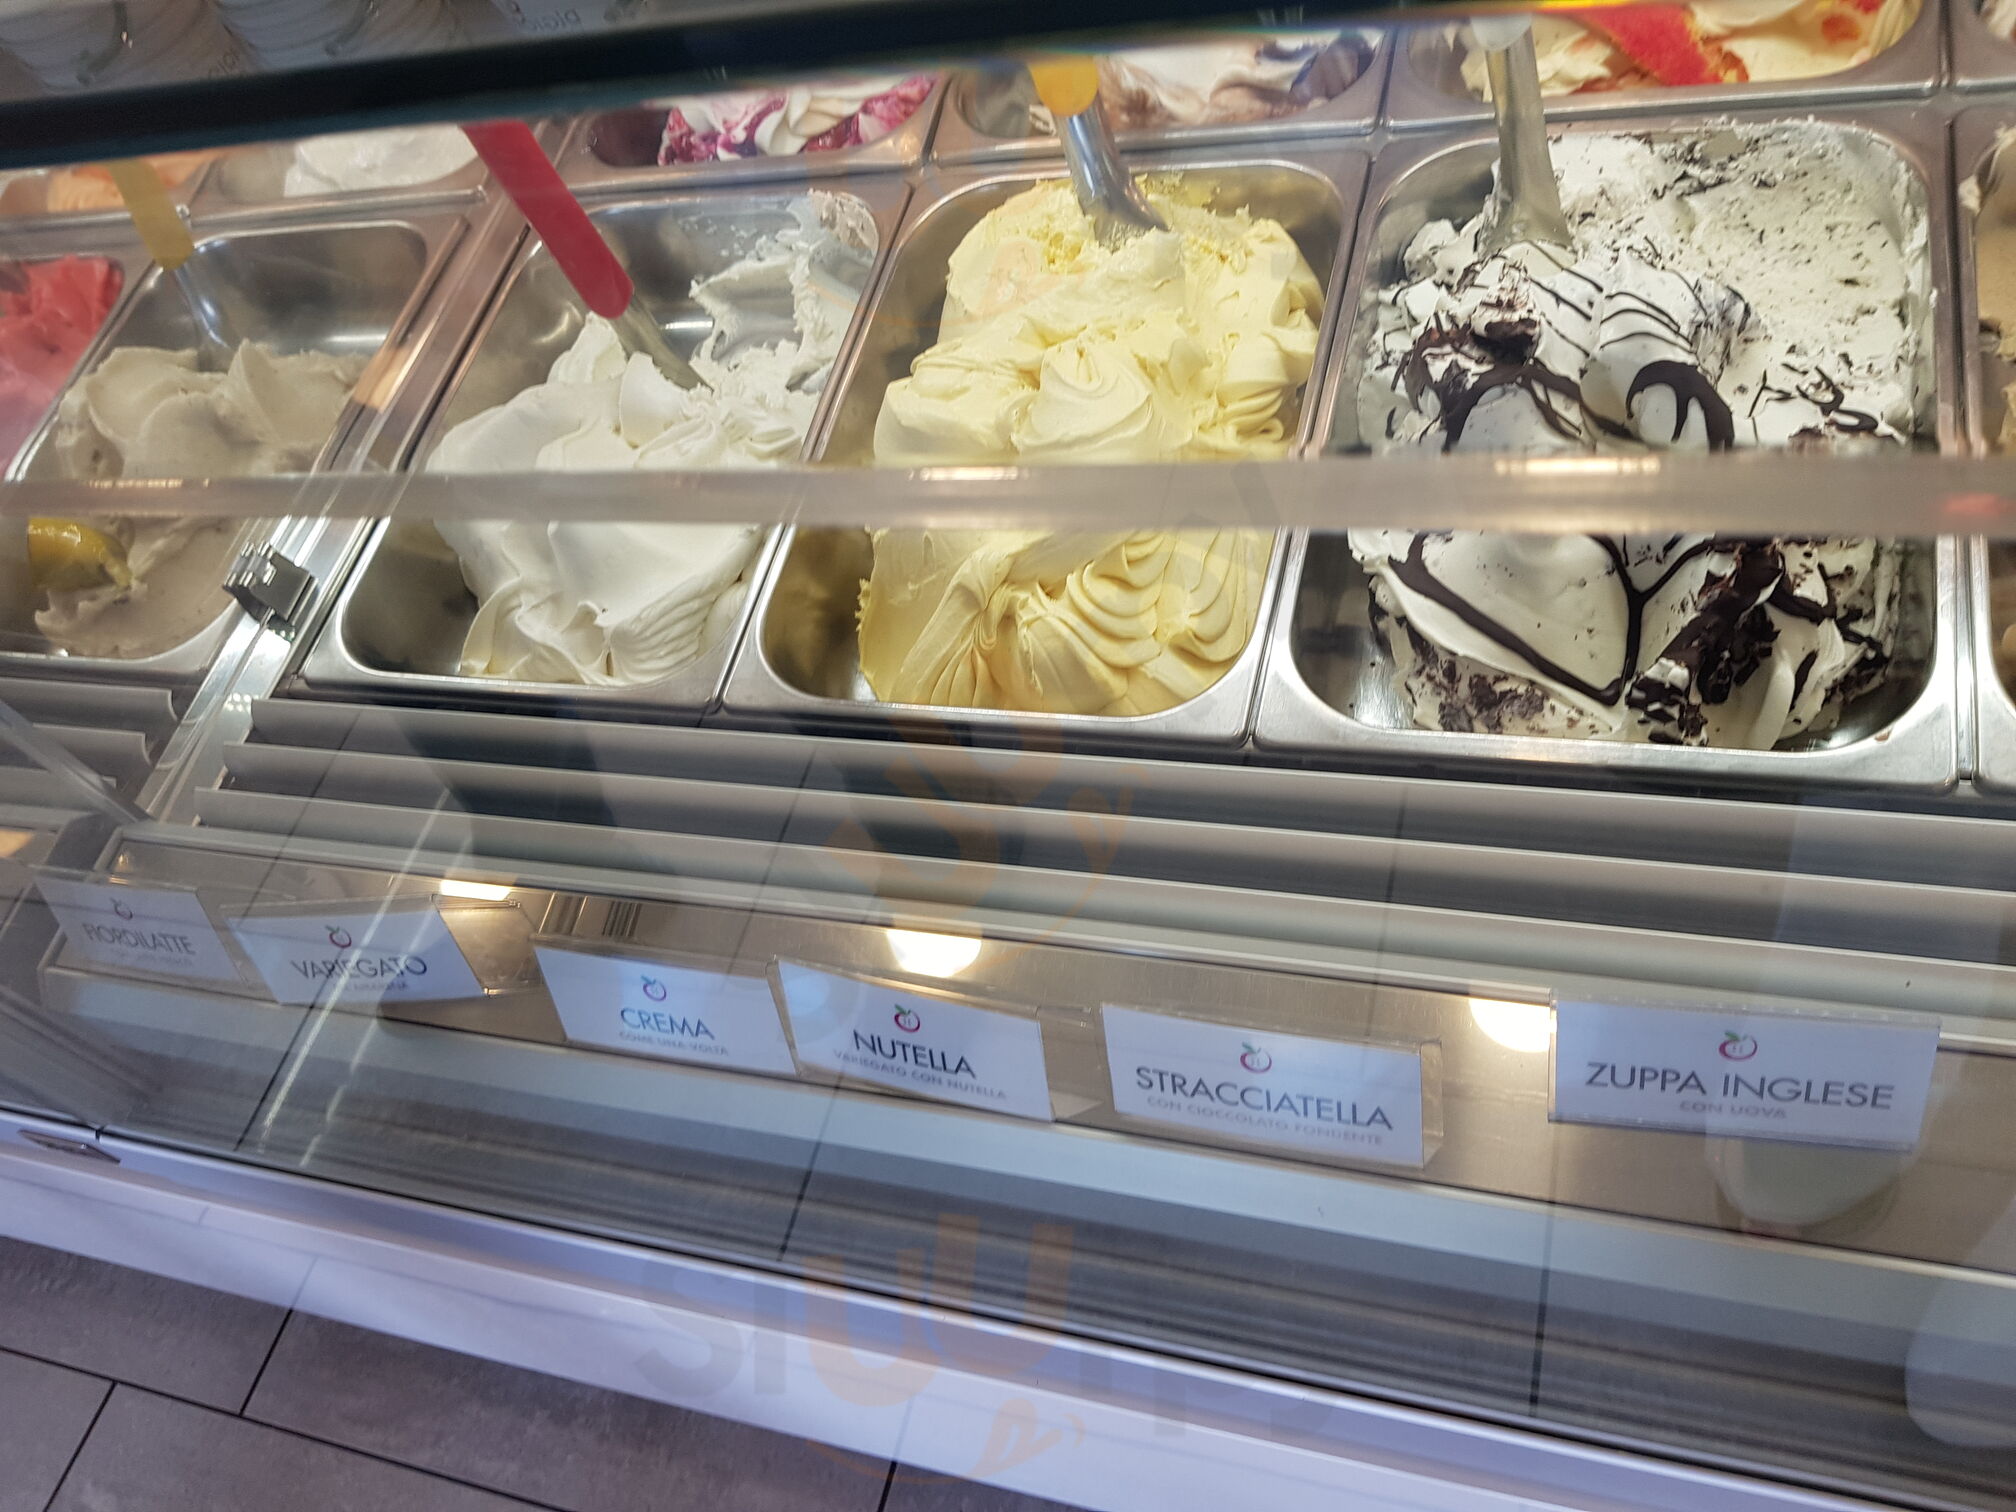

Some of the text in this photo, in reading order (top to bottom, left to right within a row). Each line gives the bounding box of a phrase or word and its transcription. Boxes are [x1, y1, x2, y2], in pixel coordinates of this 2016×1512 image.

[83, 923, 196, 955] FIORDILATTE
[290, 956, 428, 979] VARIEGATO
[620, 1006, 716, 1041] CREMA
[834, 1048, 1007, 1100] VARIEGATO CON NUTELLA
[853, 1029, 977, 1079] NUTELLA
[1135, 1066, 1394, 1131] STRACCIATELLA
[1585, 1061, 1896, 1111] ZUPPA INGLESE
[1679, 1100, 1788, 1120] CON UOVA
[1147, 1096, 1384, 1147] CON CIOCCOLATO FONDENTE
